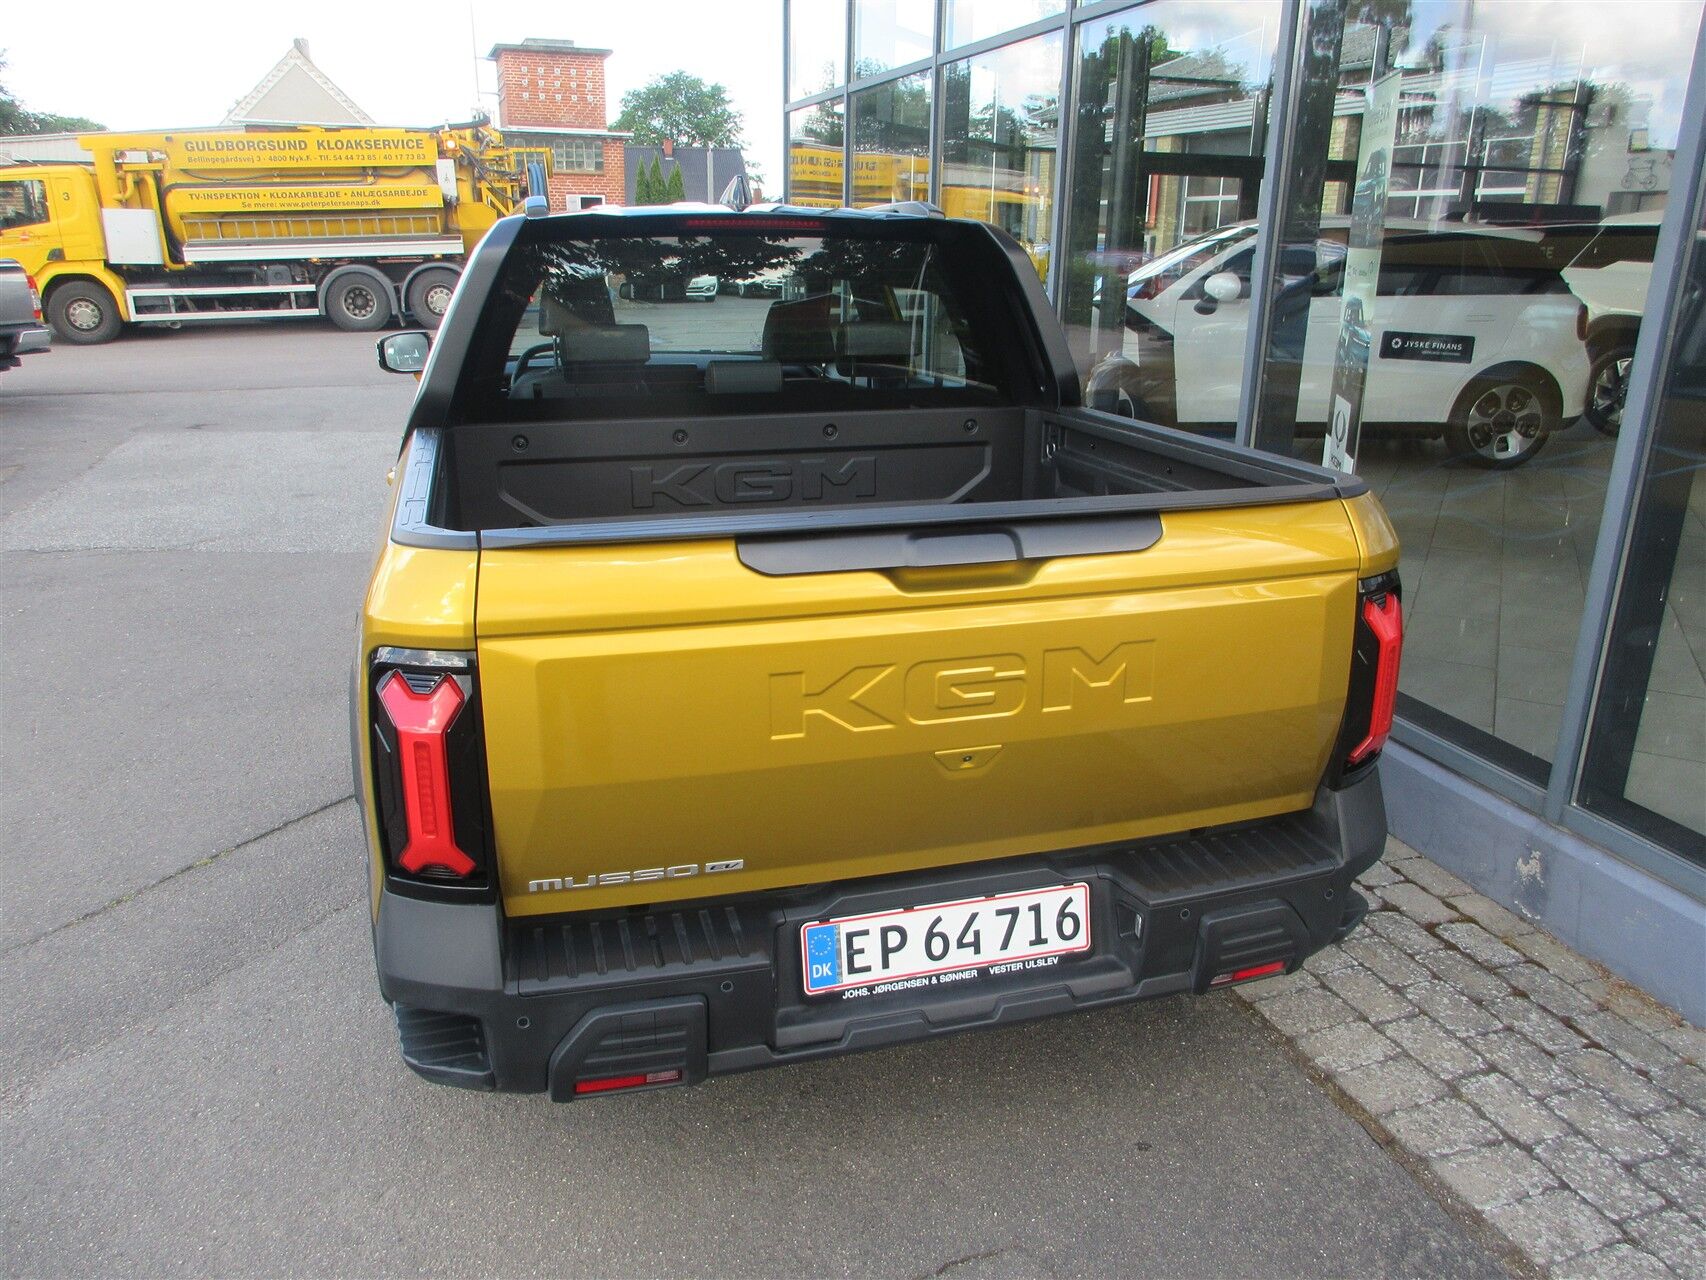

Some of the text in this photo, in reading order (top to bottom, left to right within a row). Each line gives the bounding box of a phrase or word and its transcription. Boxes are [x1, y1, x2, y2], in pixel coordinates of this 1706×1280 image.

[184, 138, 425, 152] GULDBORGSUND KLOAKSERVICE
[63, 192, 70, 200] 3
[189, 189, 428, 200] TV-INSPEKTION KLOAKARBEJDE ANLÆGSARBEJDE
[279, 199, 381, 208] www.peterpetersenaps.dk
[1404, 340, 1463, 351] JYSKE FINANS
[629, 456, 877, 509] KGM
[769, 639, 1155, 740] KGM
[845, 896, 1081, 975] EP 64 716
[812, 962, 833, 978] DK
[842, 957, 1059, 999] JOHS. JØRGENSEN & SØNNER VESTER ULSLEV
